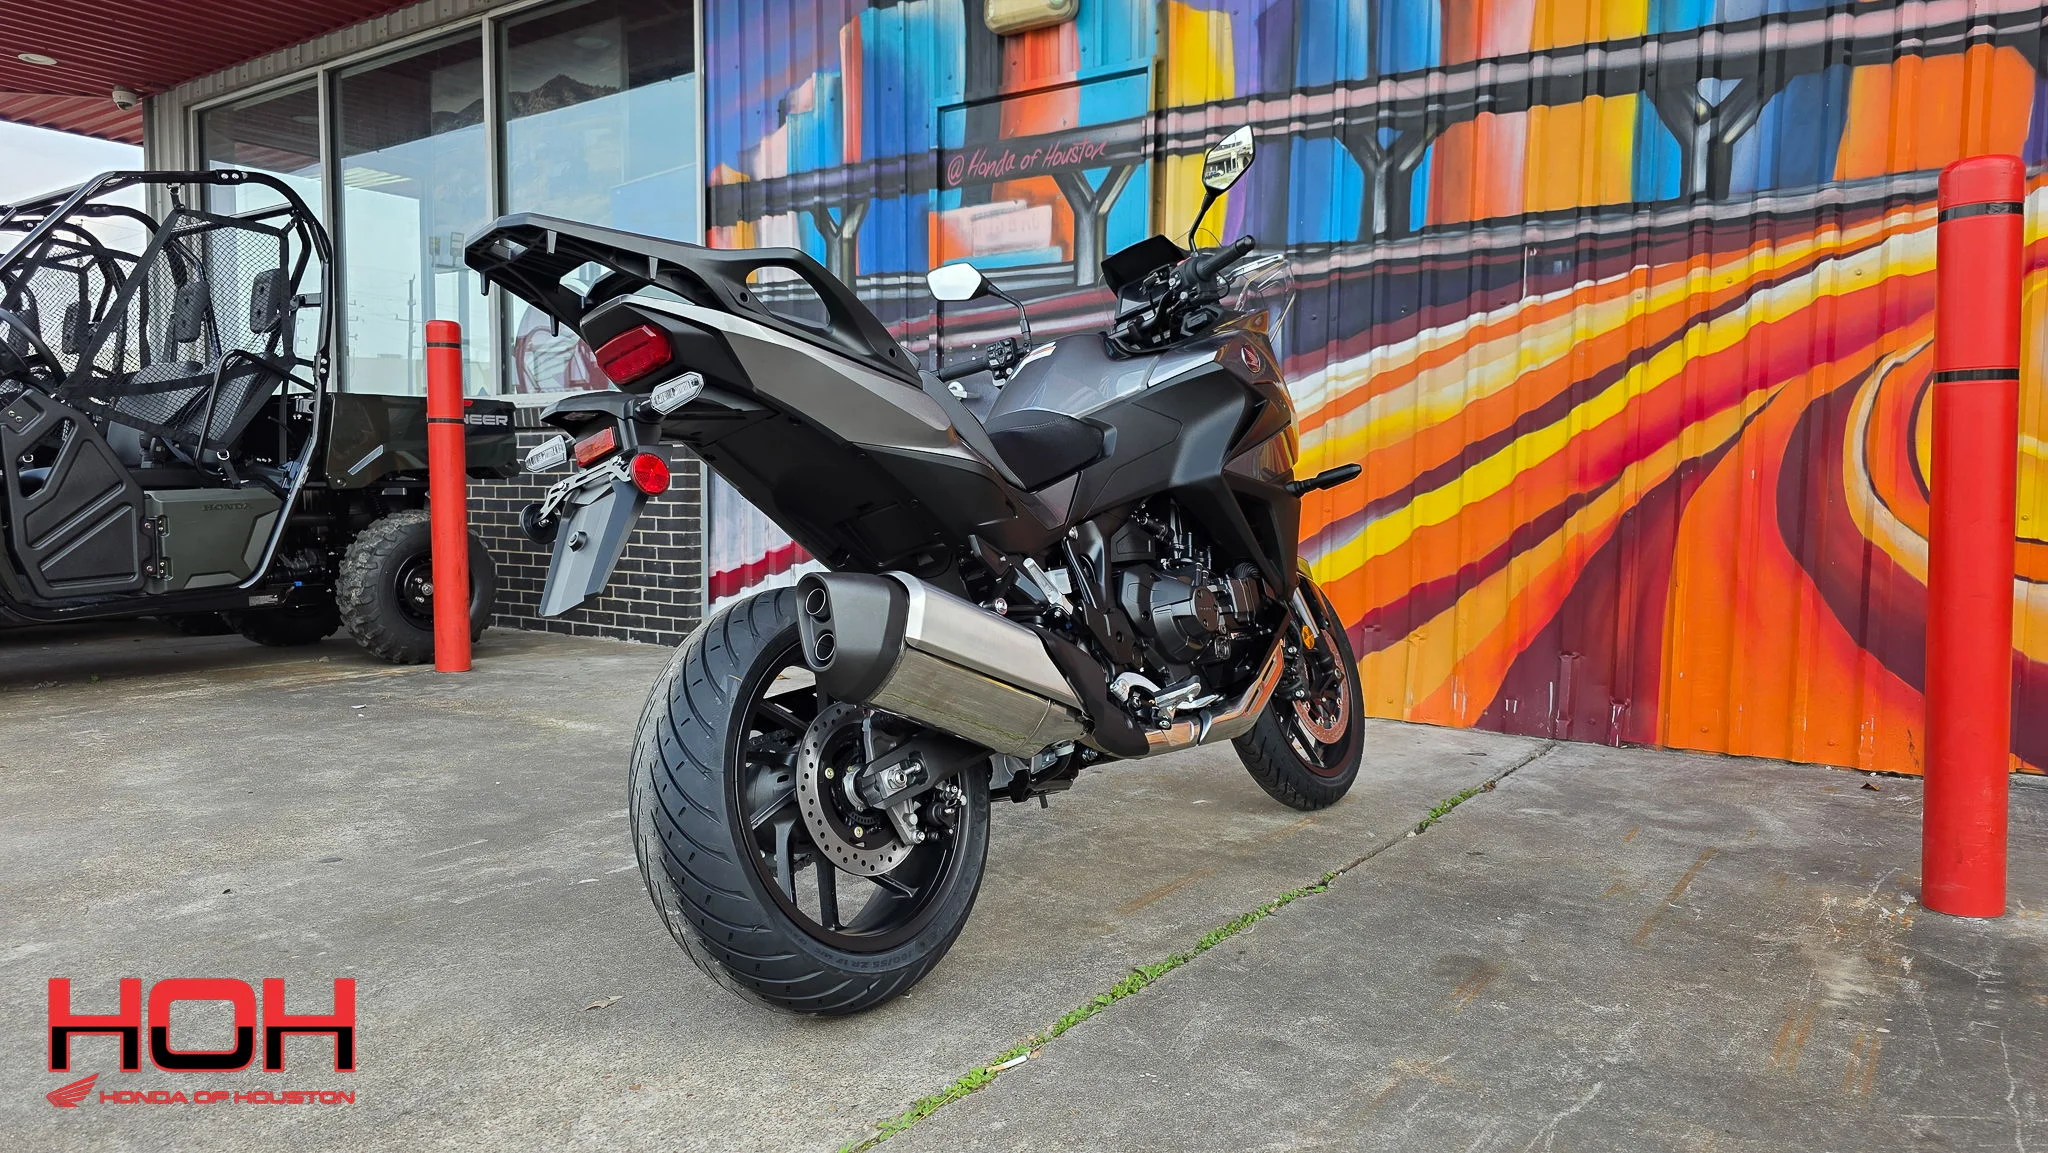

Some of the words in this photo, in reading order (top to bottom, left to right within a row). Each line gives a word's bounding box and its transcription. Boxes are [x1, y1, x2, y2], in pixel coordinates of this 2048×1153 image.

[946, 153, 965, 186] @
[967, 149, 1016, 178] Honda
[1019, 148, 1042, 170] of
[1043, 137, 1108, 168] Houston
